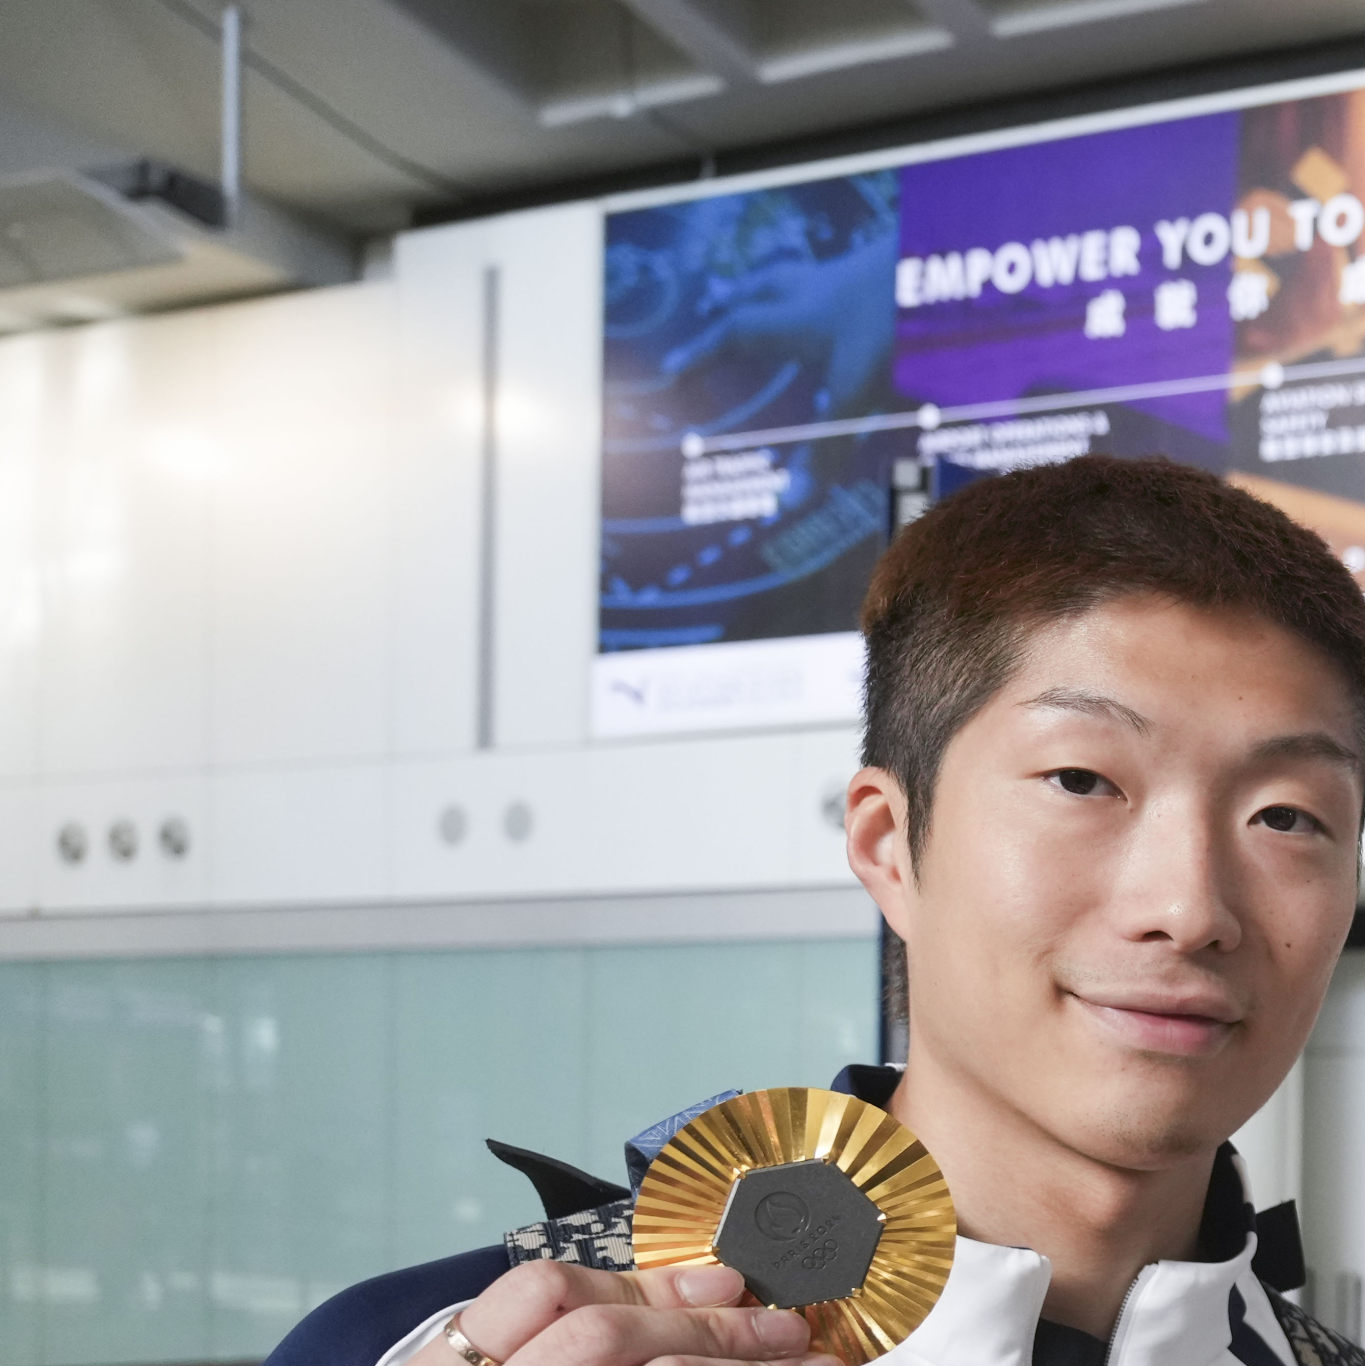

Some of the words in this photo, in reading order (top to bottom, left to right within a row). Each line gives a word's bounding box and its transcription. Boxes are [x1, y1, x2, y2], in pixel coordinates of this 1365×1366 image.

[894, 225, 1141, 308] EMPOWER
[1154, 206, 1271, 270] YOU
[1289, 192, 1365, 247] TO
